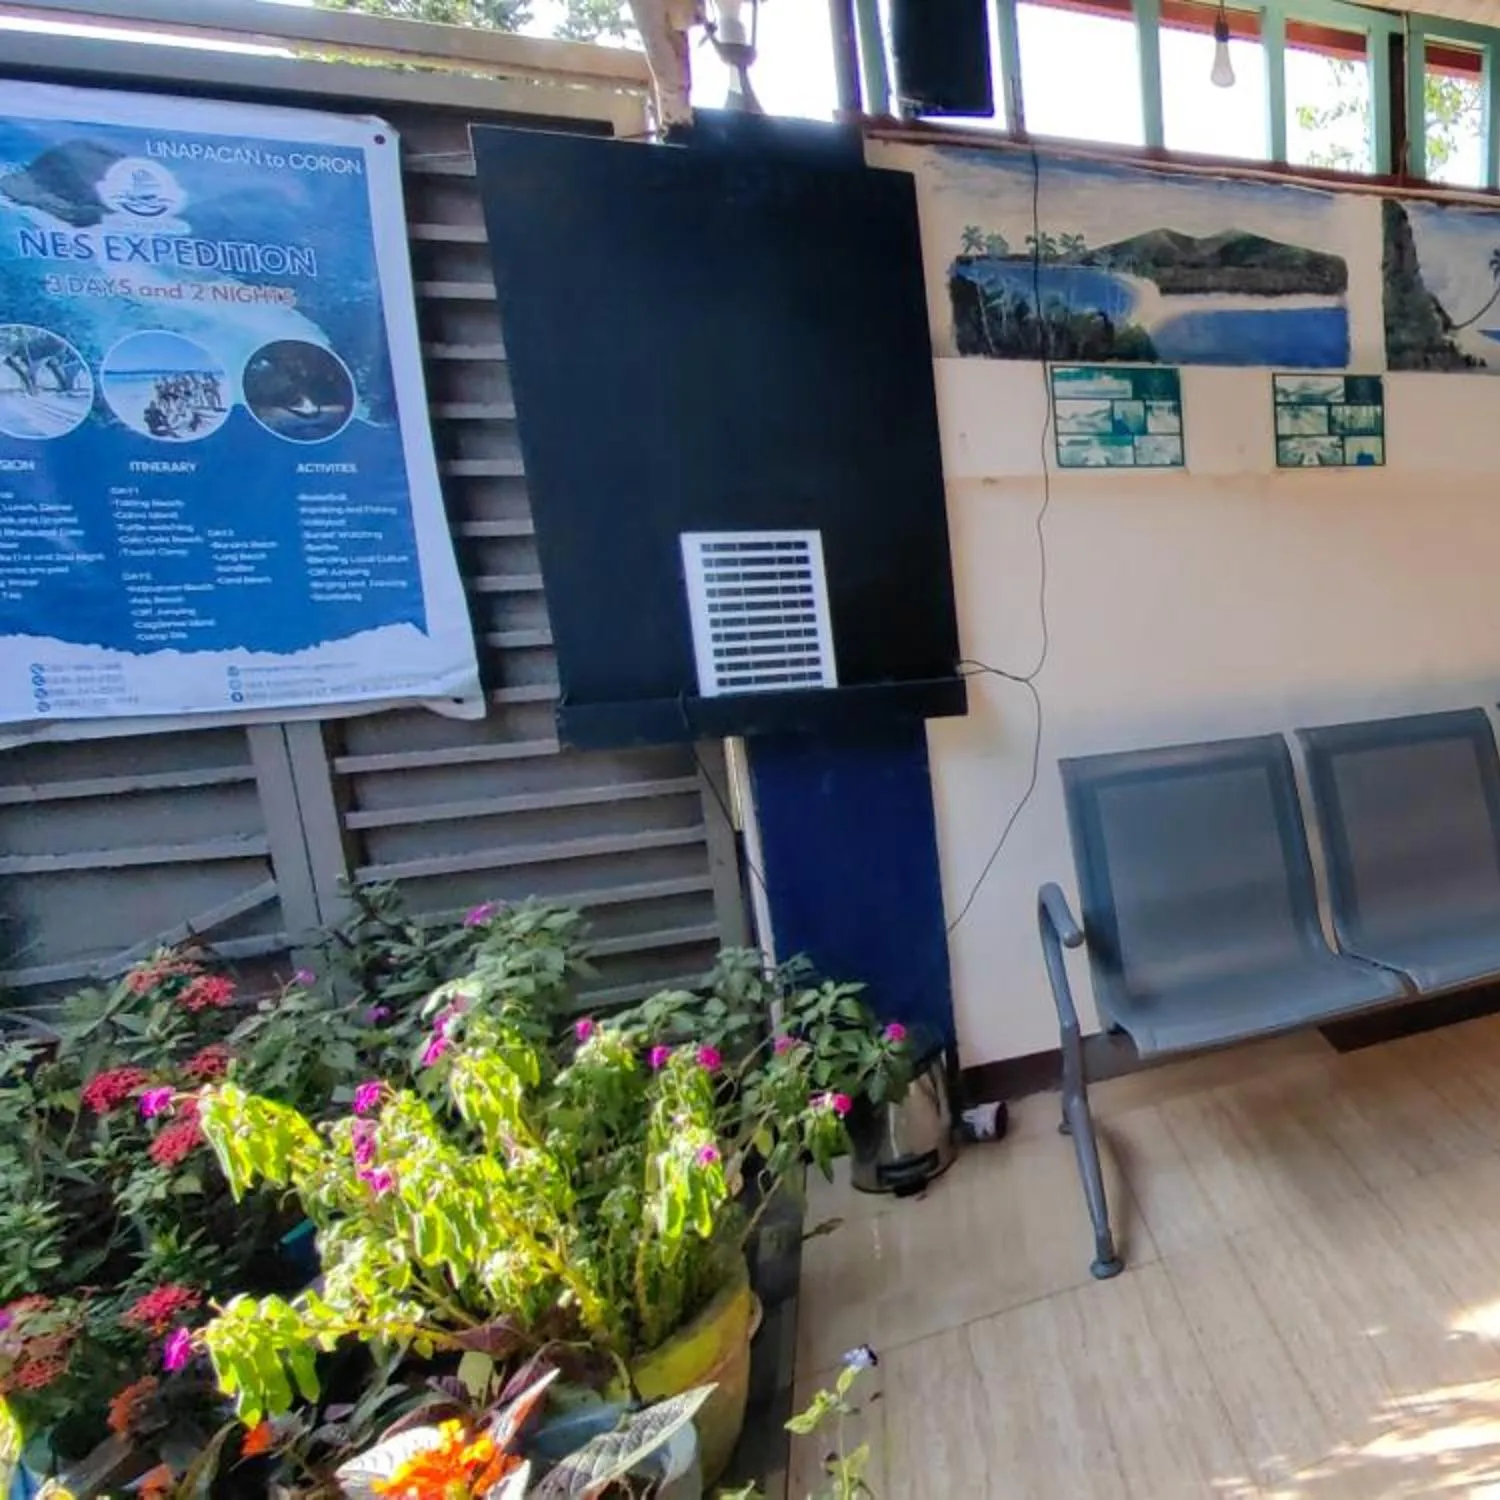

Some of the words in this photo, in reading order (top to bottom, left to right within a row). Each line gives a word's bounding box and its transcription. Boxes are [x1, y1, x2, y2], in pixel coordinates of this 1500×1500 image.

[146, 139, 261, 167] LINAPACAN
[266, 154, 285, 169] to
[288, 153, 362, 176] CORON
[18, 228, 95, 261] NES
[102, 233, 318, 277] EXPEDITION
[45, 272, 62, 294] 3
[67, 275, 132, 297] DAYS
[138, 283, 183, 300] and
[190, 284, 205, 301] 2
[211, 285, 297, 306] NIGHTS
[129, 461, 196, 472] ITINERARY
[296, 463, 358, 474] ACTIVITIES
